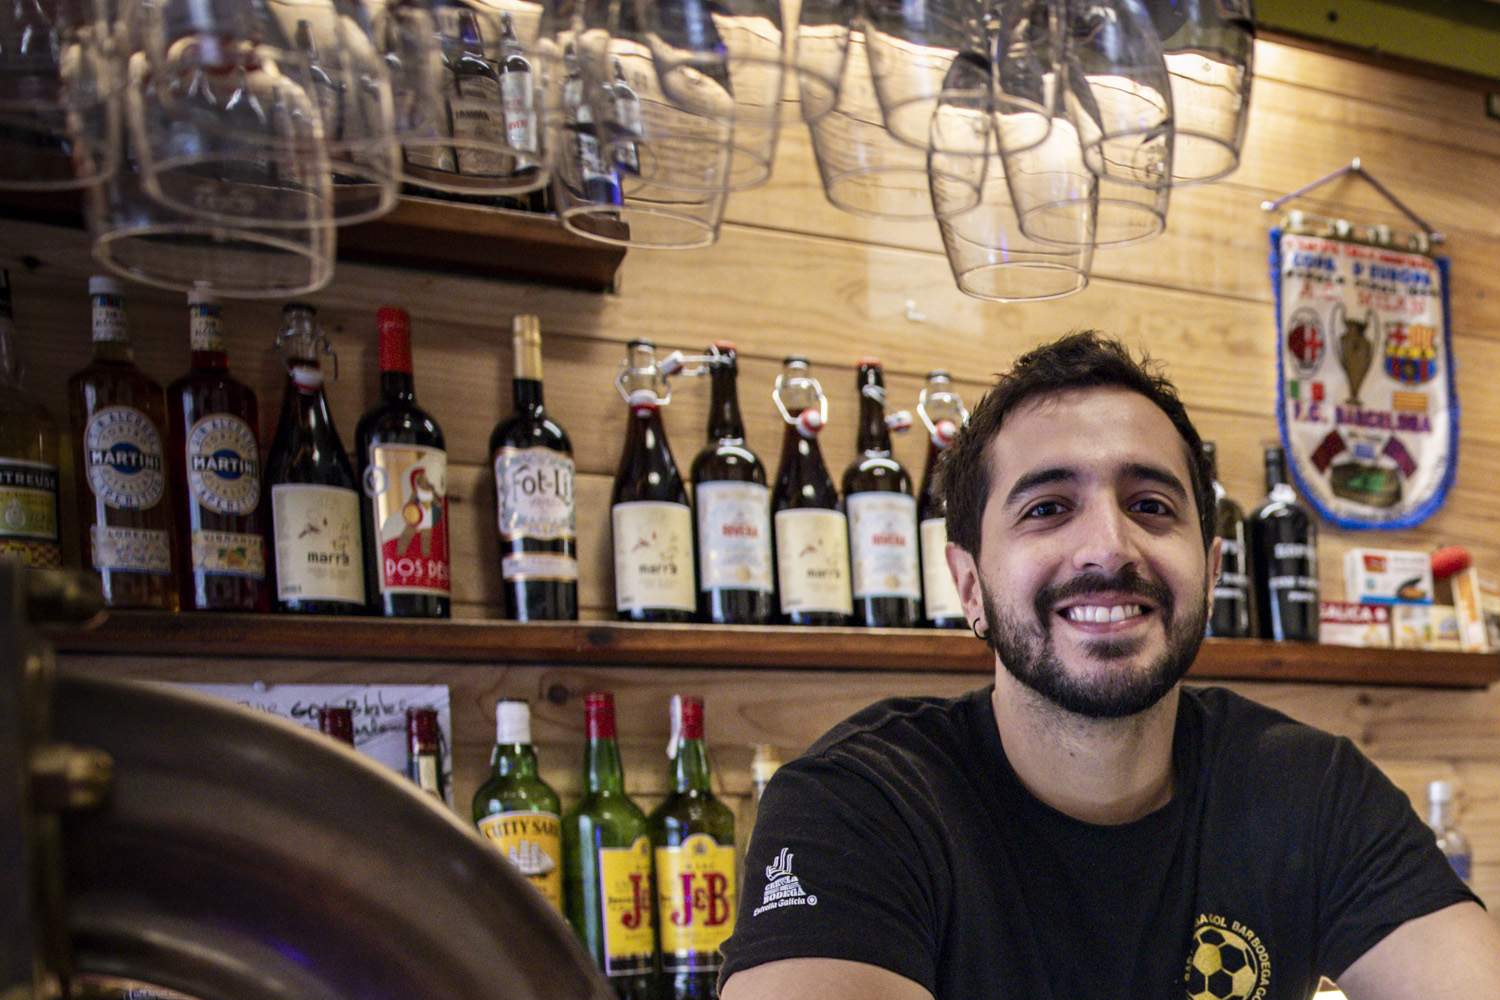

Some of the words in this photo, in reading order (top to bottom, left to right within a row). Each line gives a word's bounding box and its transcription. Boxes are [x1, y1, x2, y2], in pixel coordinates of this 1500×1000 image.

[90, 449, 161, 471] MARTINI
[192, 455, 257, 478] MARTINI
[386, 558, 423, 578] DOS
[485, 820, 527, 839] CUTTY
[778, 897, 806, 907] Galicia
[1231, 921, 1255, 940] BAR
[1251, 937, 1271, 986] BODEGA
